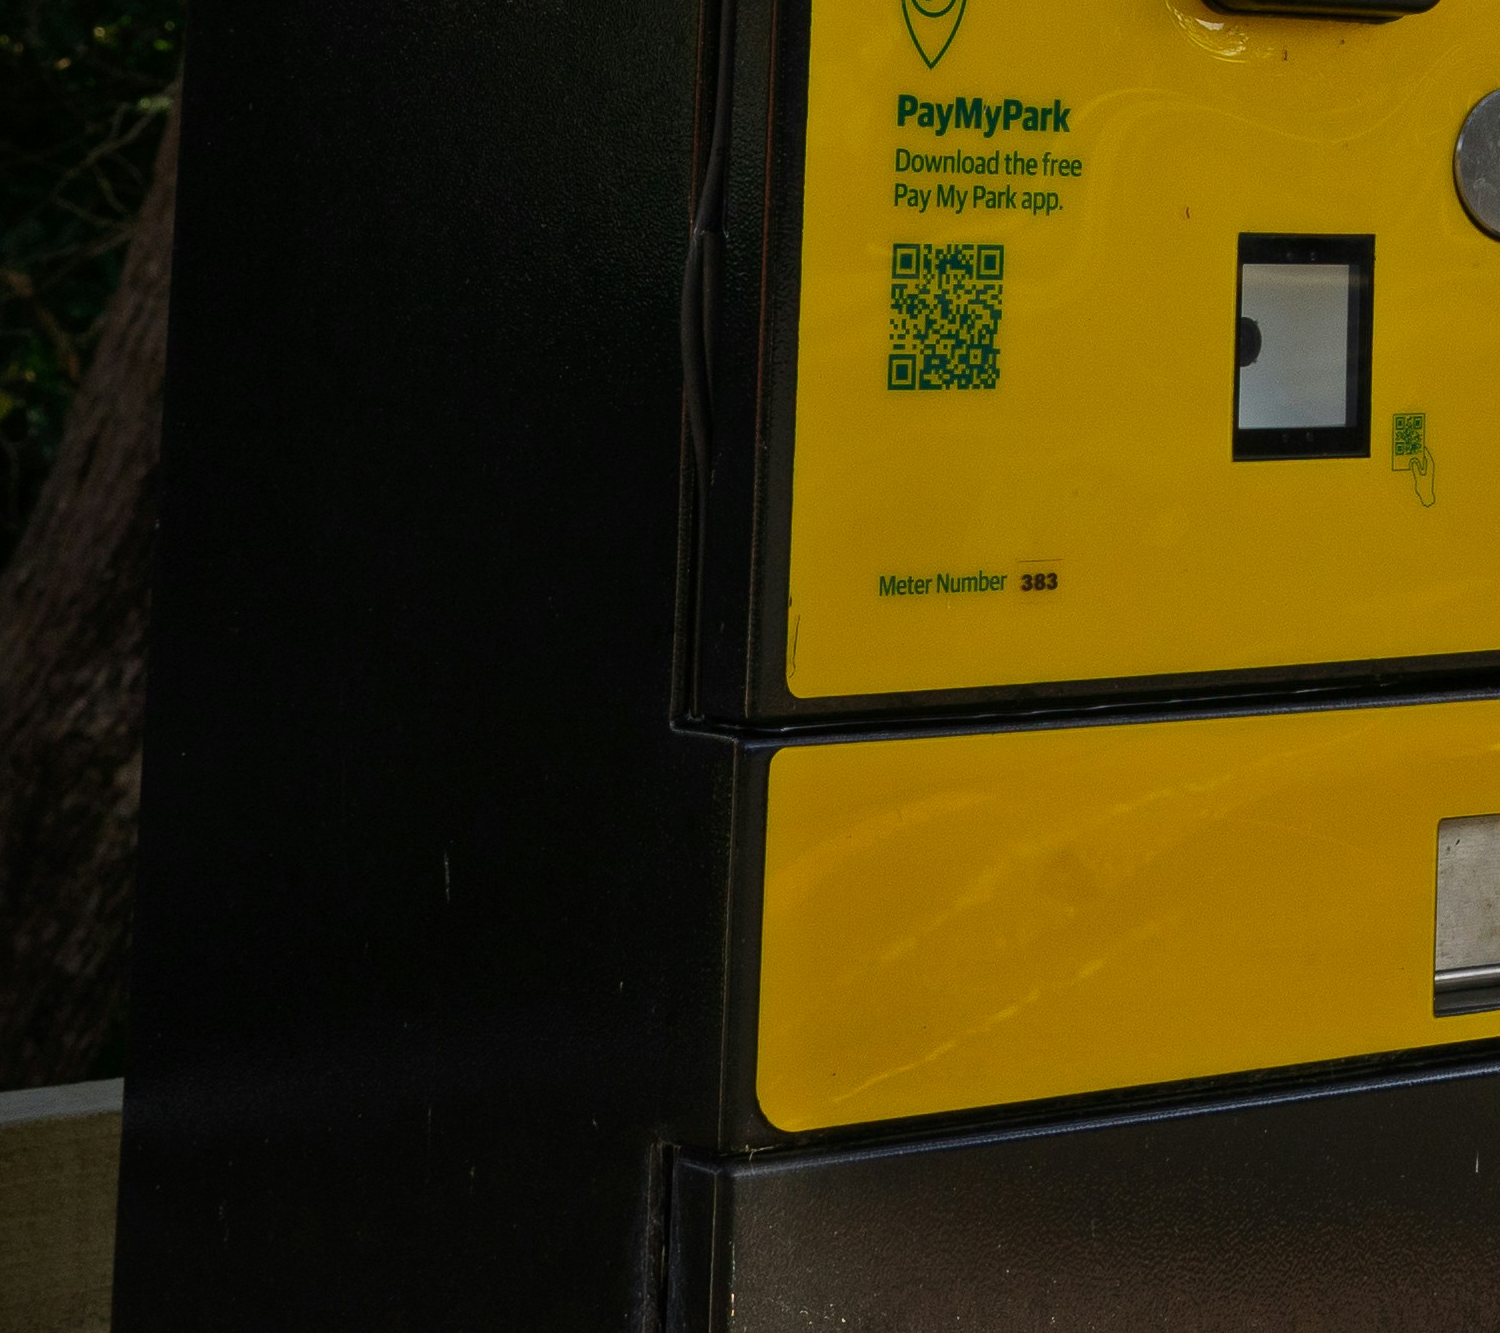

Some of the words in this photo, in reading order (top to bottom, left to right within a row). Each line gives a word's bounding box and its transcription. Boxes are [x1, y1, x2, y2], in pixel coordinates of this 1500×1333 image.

[897, 94, 1072, 138] PayMyPark
[895, 148, 1000, 175] Download
[1003, 150, 1038, 176] the
[1041, 152, 1083, 177] free
[893, 183, 932, 214] Pay
[936, 184, 969, 215] My
[972, 184, 1018, 210] Park
[1021, 190, 1064, 216] app.
[879, 575, 933, 597] Meter
[936, 570, 1008, 594] Number
[1020, 572, 1059, 592] 383
